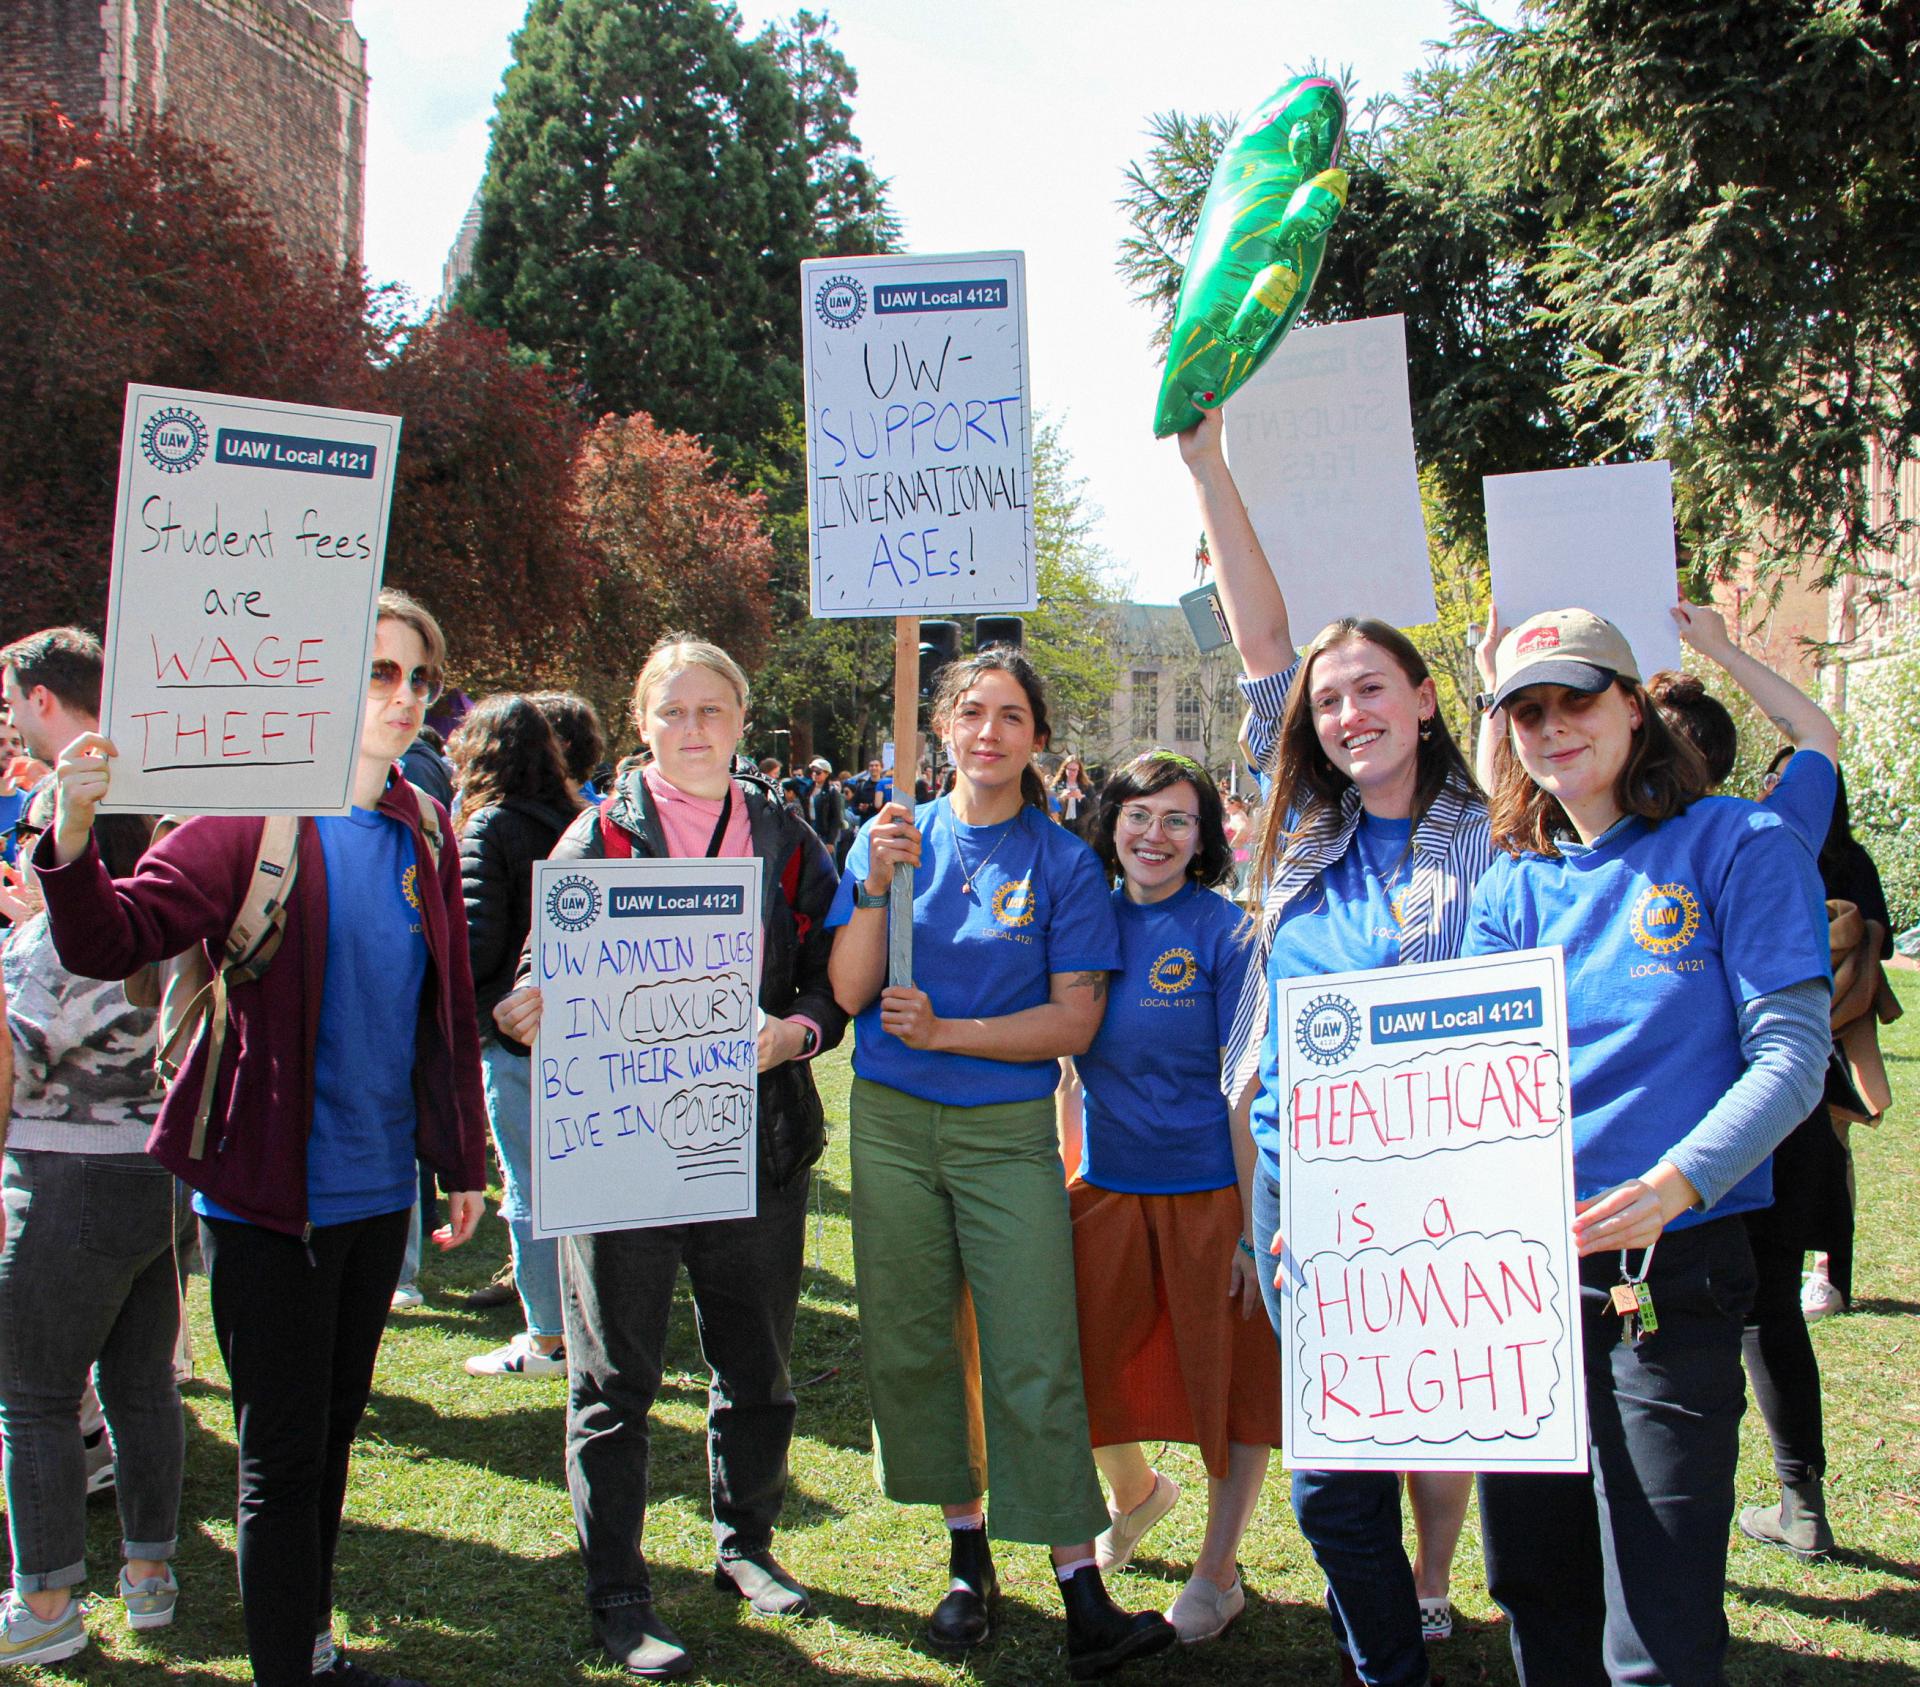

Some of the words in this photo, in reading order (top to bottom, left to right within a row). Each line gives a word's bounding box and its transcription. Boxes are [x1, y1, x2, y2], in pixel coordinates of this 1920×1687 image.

[830, 296, 852, 308] UAW
[881, 292, 917, 307] UAW
[922, 289, 962, 306] Local
[967, 287, 1000, 303] 4121
[160, 432, 189, 448] UAW
[821, 397, 1020, 467] SUPPORT
[225, 439, 271, 459] UAW
[275, 445, 323, 466] Local
[327, 452, 368, 471] 4121
[818, 466, 1027, 529] INTERNATIONAL
[141, 494, 274, 560] Student
[295, 508, 371, 562] fees
[203, 588, 272, 619] are
[150, 633, 325, 684] WAGE
[131, 711, 331, 766] THEFT
[562, 897, 586, 910] UAW
[616, 896, 654, 910] UAW
[658, 895, 699, 909] Local
[703, 894, 737, 908] 4121
[1647, 907, 1679, 926] UAW
[542, 939, 590, 979] UW
[597, 936, 693, 978] ADMIN
[705, 932, 754, 970] LIVES
[1015, 934, 1032, 944] 4121
[1630, 962, 1674, 978] LOCAL
[1677, 959, 1704, 971] 4121
[565, 996, 611, 1039] IN
[633, 987, 751, 1034] LUXURY
[1140, 998, 1171, 1007] LOCAL
[1173, 999, 1195, 1007] 4121
[1379, 1012, 1425, 1035] UAW
[1431, 1005, 1483, 1029] Local
[1489, 999, 1533, 1023] 4121
[1313, 1022, 1342, 1039] UAW
[543, 1056, 584, 1099] BC
[599, 1046, 683, 1094] THEIR
[688, 1040, 756, 1078] WORKERS
[1293, 1054, 1559, 1149] HEALTHCARE
[547, 1112, 603, 1160] LIVE
[614, 1104, 656, 1137] IN
[1334, 1189, 1375, 1244] is
[1422, 1197, 1455, 1237] a
[1315, 1255, 1542, 1336] HUMAN
[1321, 1339, 1547, 1419] RIGHT
